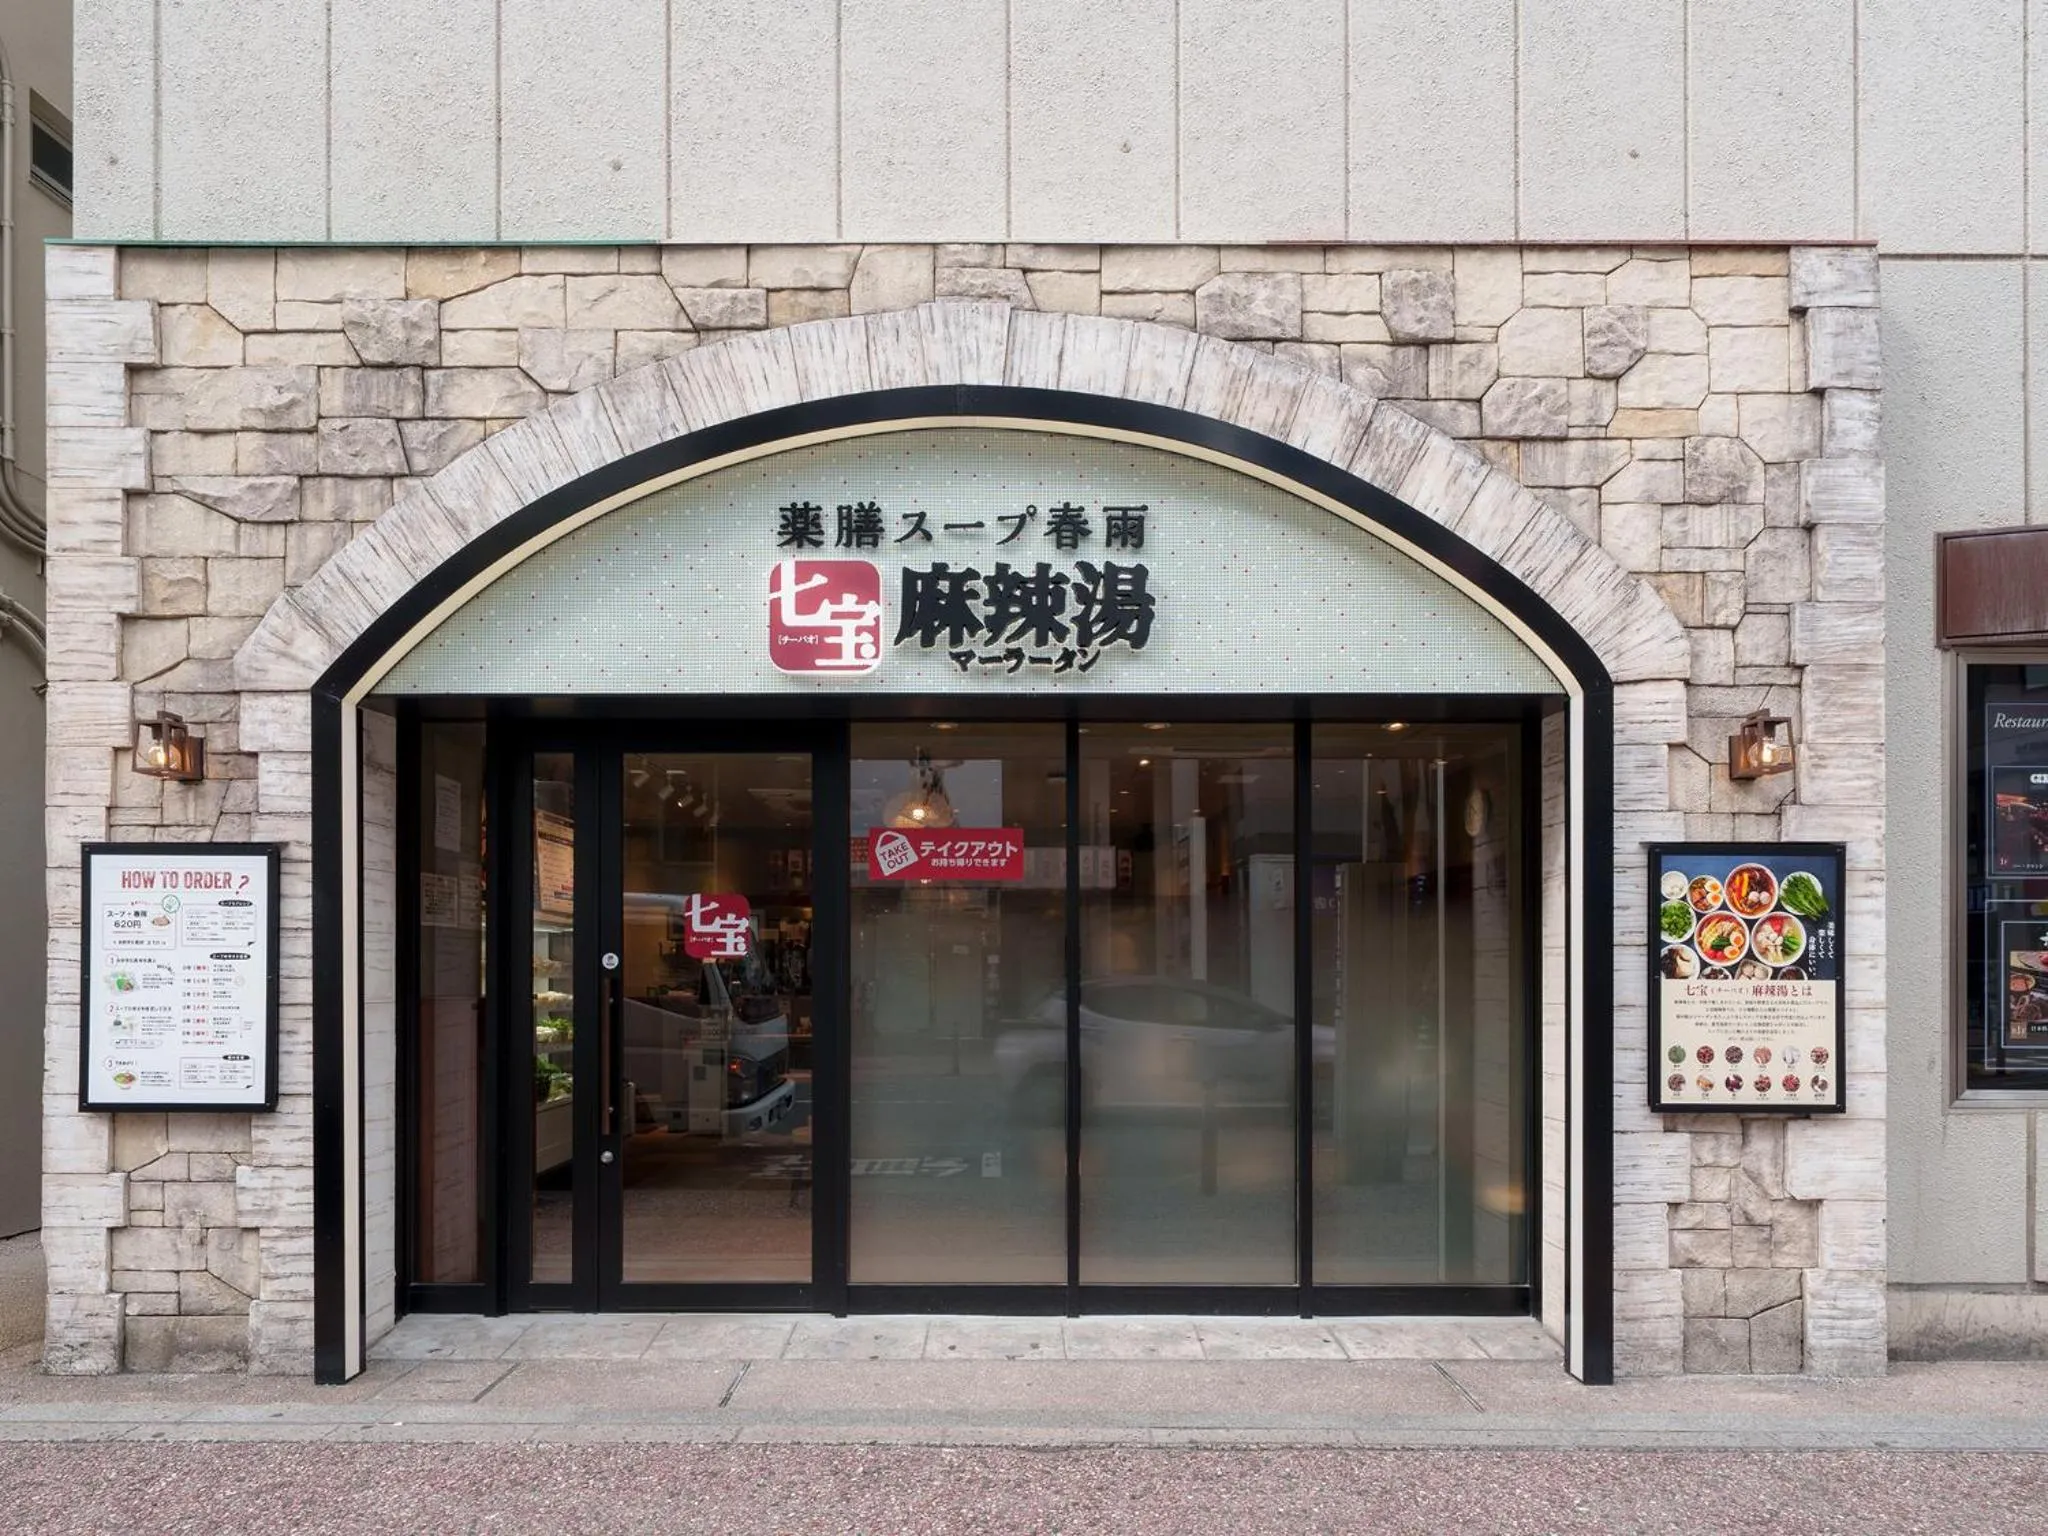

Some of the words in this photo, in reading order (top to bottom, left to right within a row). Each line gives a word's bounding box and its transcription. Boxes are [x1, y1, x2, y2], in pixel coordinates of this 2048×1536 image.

[777, 501, 1148, 549] 薬膳スープ春雨
[769, 560, 881, 666] 七宝
[894, 562, 1156, 649] 麻辣湯
[948, 648, 1101, 674] マーラータン
[880, 841, 909, 861] TAKE
[920, 841, 1018, 857] テイクアウト
[887, 852, 908, 868] OUT
[931, 858, 1007, 867] お持ち帰りできます
[122, 871, 156, 889] HOW
[160, 871, 179, 889] TO
[184, 871, 232, 889] ORDER
[114, 919, 141, 928] 620円
[684, 894, 749, 956] 七宝
